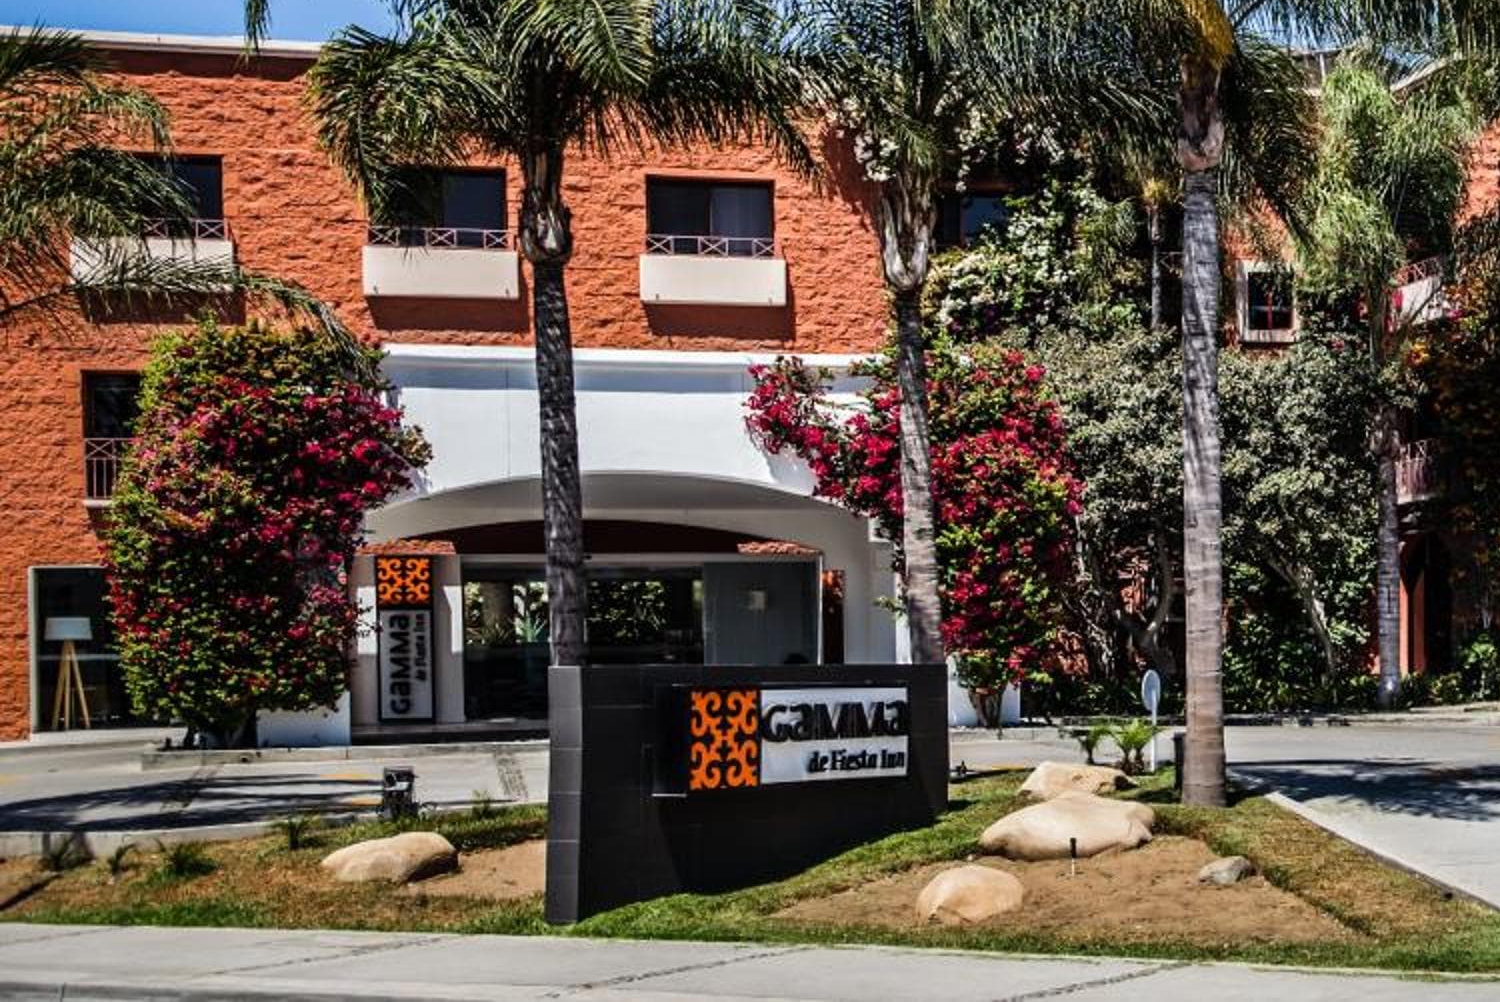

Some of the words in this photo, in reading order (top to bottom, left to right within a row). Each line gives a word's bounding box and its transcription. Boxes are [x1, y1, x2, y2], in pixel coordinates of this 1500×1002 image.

[807, 750, 828, 773] de
[831, 748, 877, 771] Fiesta
[881, 748, 905, 768] Inn
